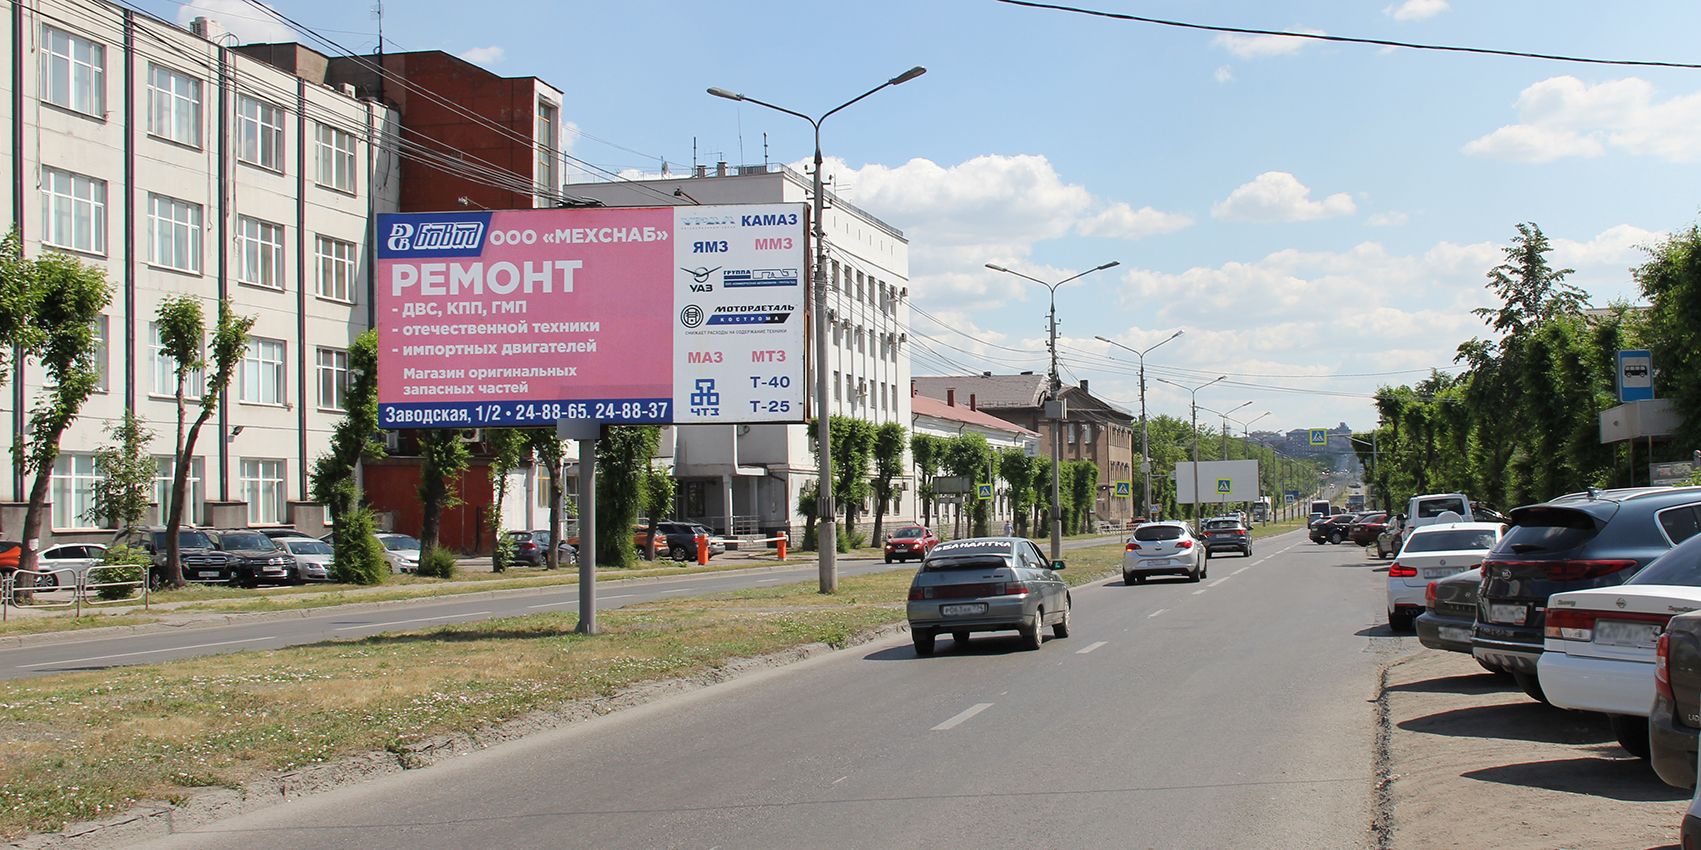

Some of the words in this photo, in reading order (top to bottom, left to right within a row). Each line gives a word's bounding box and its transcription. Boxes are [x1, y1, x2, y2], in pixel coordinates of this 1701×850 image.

[742, 214, 798, 227] КАМАЗ
[489, 229, 537, 246] ООО
[543, 226, 669, 245] «МЕХСНАБ»
[693, 240, 729, 253] ЯМЗ
[755, 238, 793, 250] ММЗ
[392, 260, 583, 296] РЕМОНТ
[690, 284, 713, 292] УАЗ
[402, 302, 442, 317] ДВС,
[447, 301, 487, 316] КПП,
[492, 300, 527, 314] ГМП
[403, 320, 528, 336] отечественной
[532, 321, 600, 334] техники
[403, 343, 497, 357] импортных
[501, 338, 597, 355] двигателей
[688, 352, 723, 363] МАЗ
[752, 350, 786, 362] МТЗ
[403, 367, 464, 379] Магазин
[469, 366, 577, 380] оригинальных
[750, 376, 790, 388] Т-40
[403, 384, 474, 396] запасных
[478, 382, 529, 394] частей
[385, 407, 472, 424] Заводская,
[475, 404, 501, 421] 1/2
[595, 402, 668, 419] 24-88-37
[691, 408, 719, 416] ЧТЗ
[750, 401, 790, 412] Т-25
